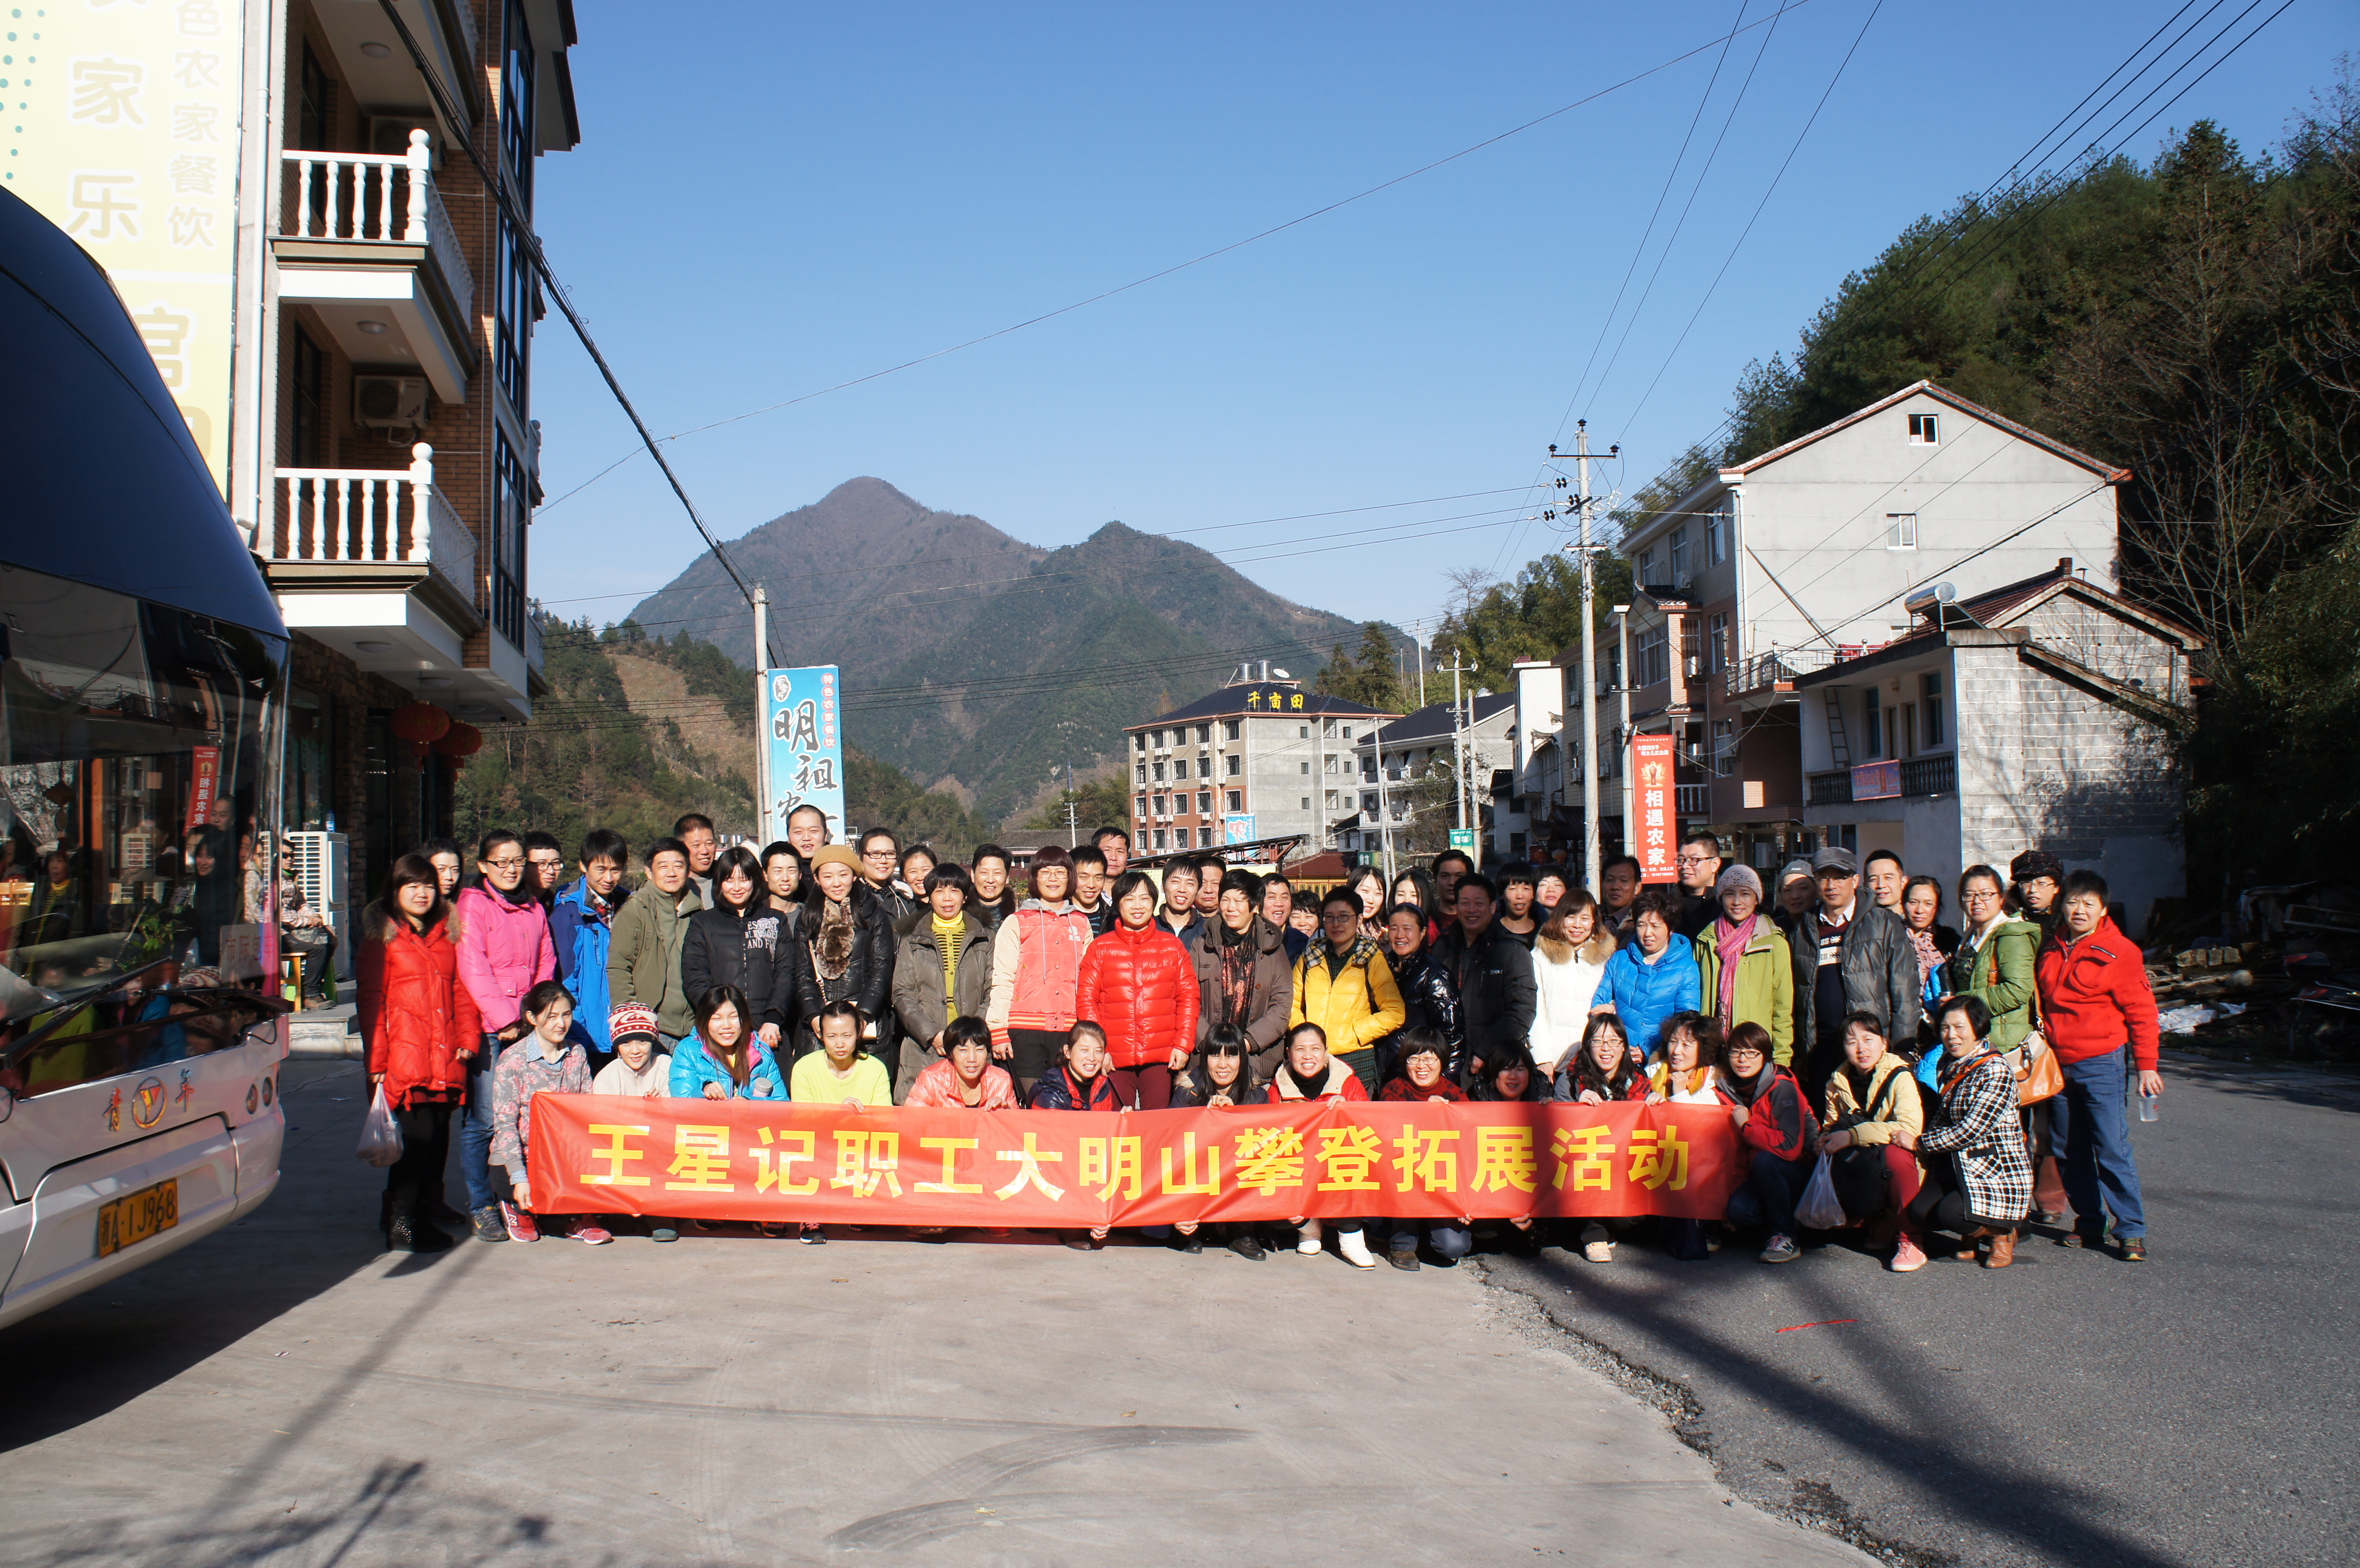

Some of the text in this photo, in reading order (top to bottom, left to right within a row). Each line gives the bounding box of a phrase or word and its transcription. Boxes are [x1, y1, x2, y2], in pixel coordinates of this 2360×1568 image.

[68, 0, 145, 239] 家乐
[823, 674, 835, 747] 特色农家餐饮
[1247, 691, 1303, 710] 千亩田
[1645, 789, 1666, 865] 相遇农家
[580, 1123, 1689, 1202] 王星记职工大明山攀登拓展活动
